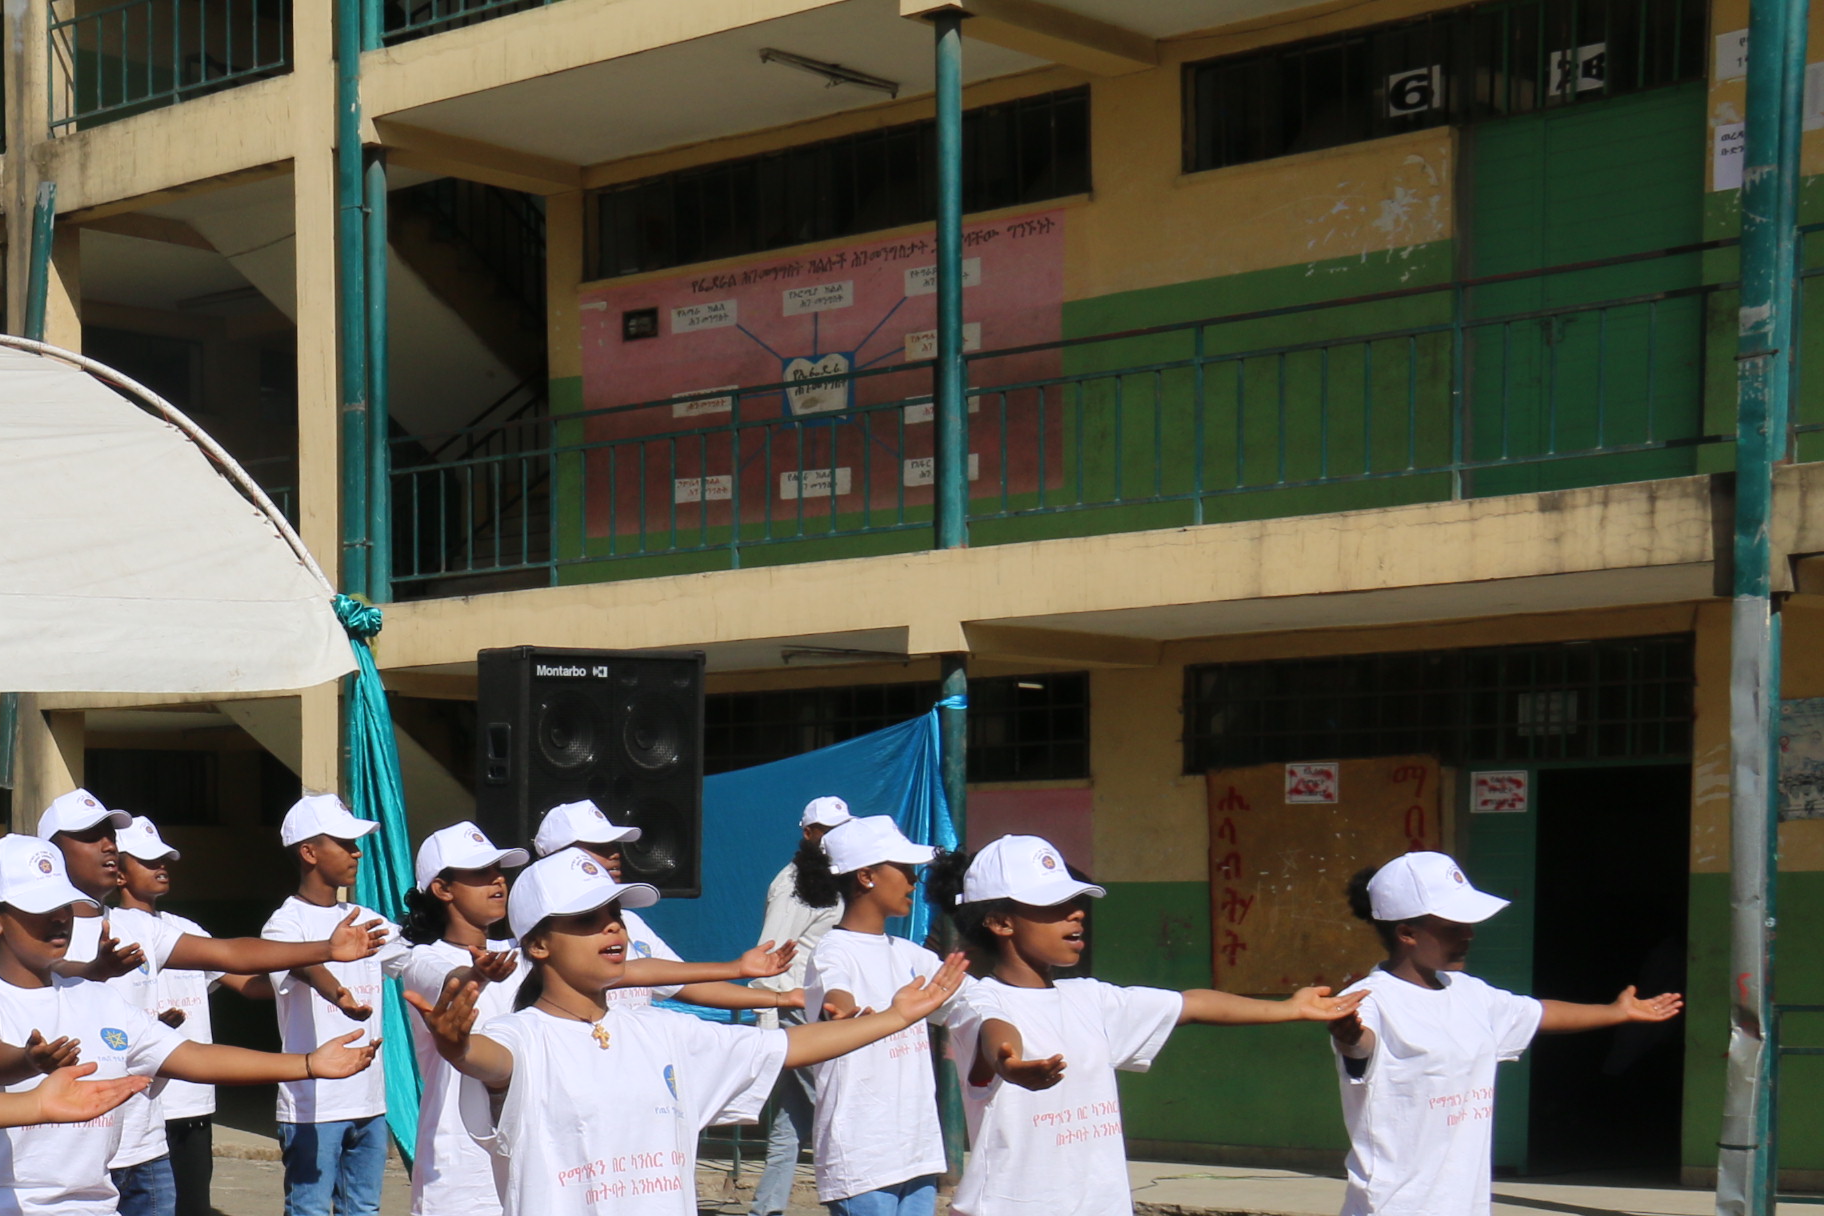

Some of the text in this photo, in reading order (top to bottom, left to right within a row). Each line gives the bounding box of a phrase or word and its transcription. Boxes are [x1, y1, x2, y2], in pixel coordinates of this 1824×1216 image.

[1389, 73, 1433, 111] 6
[536, 664, 587, 679] Montarbo
[612, 1157, 627, 1173] በር
[585, 1179, 627, 1205] በክትባት
